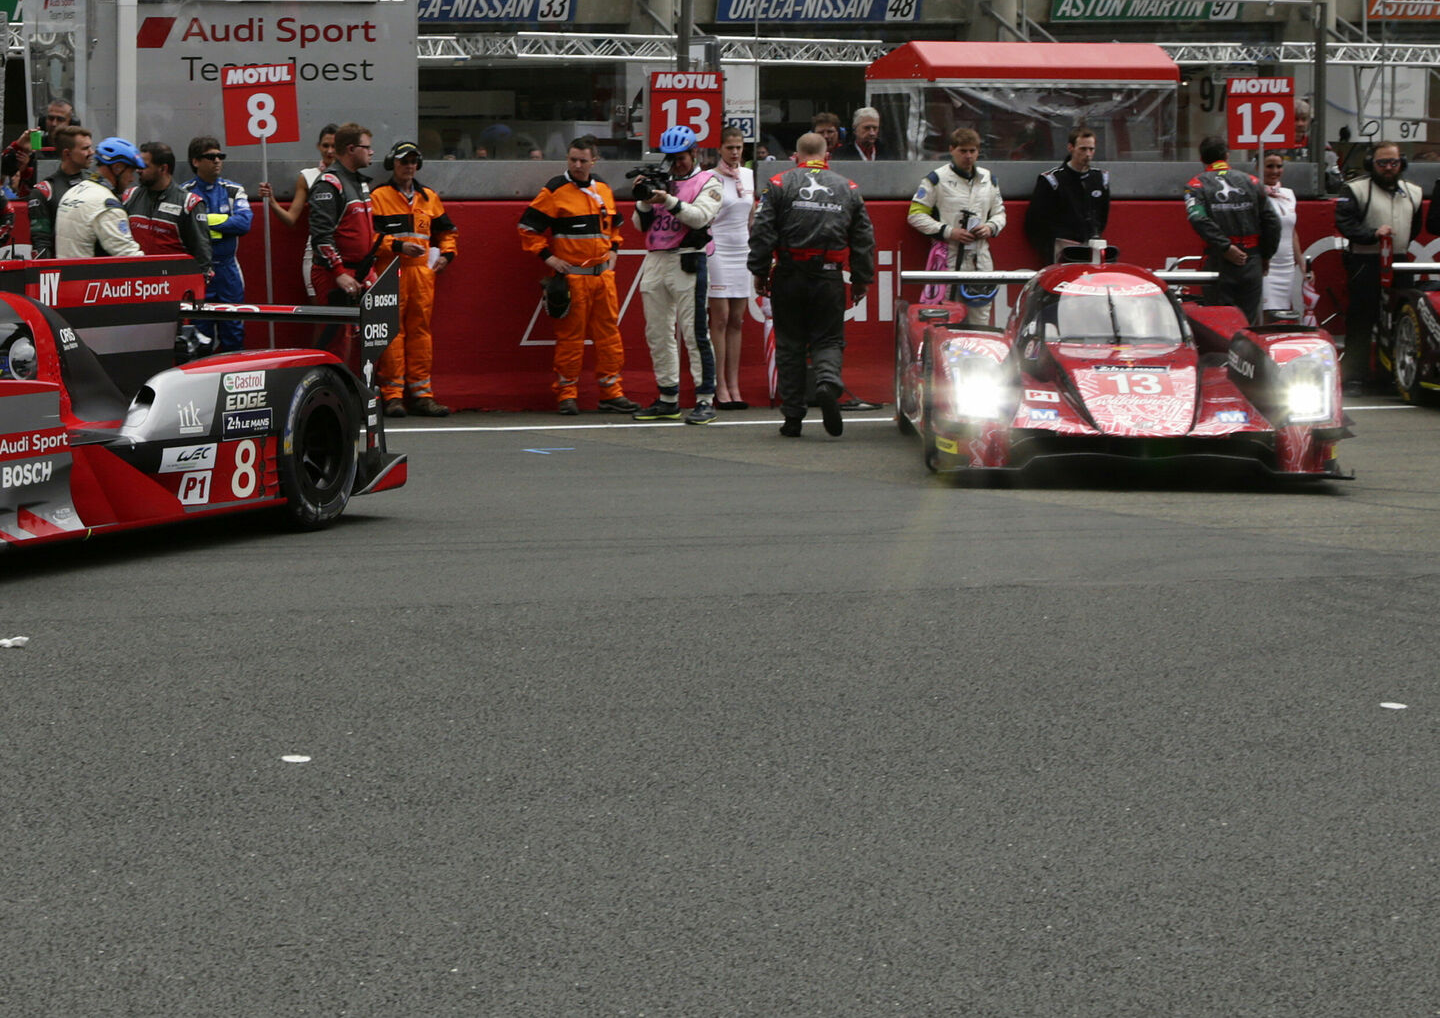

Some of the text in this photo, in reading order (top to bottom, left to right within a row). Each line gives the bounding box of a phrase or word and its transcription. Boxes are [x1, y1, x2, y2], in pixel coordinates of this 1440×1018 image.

[181, 17, 376, 49] Audi Sport
[226, 66, 291, 85] MOTUL
[655, 73, 718, 90] MOTUL
[1230, 78, 1290, 94] MOTUL
[247, 93, 278, 139] 8
[661, 98, 711, 142] 13
[1236, 102, 1285, 143] 12
[1400, 121, 1421, 139] 97
[40, 272, 61, 307] HY
[102, 280, 170, 300] Audi Sport
[374, 294, 398, 307] BOSCH
[60, 327, 76, 343] ORIS
[364, 323, 389, 340] ORIS
[234, 374, 263, 390] Castrol
[1107, 373, 1163, 394] 13
[226, 391, 269, 410] EDGE
[177, 400, 203, 428] itk
[241, 420, 252, 428] LE
[250, 418, 270, 427] MANS
[0, 432, 69, 456] Audi Sport
[176, 447, 212, 462] WEC
[2, 461, 53, 488] BOSCH
[231, 439, 256, 499] 8
[183, 476, 207, 500] P1
